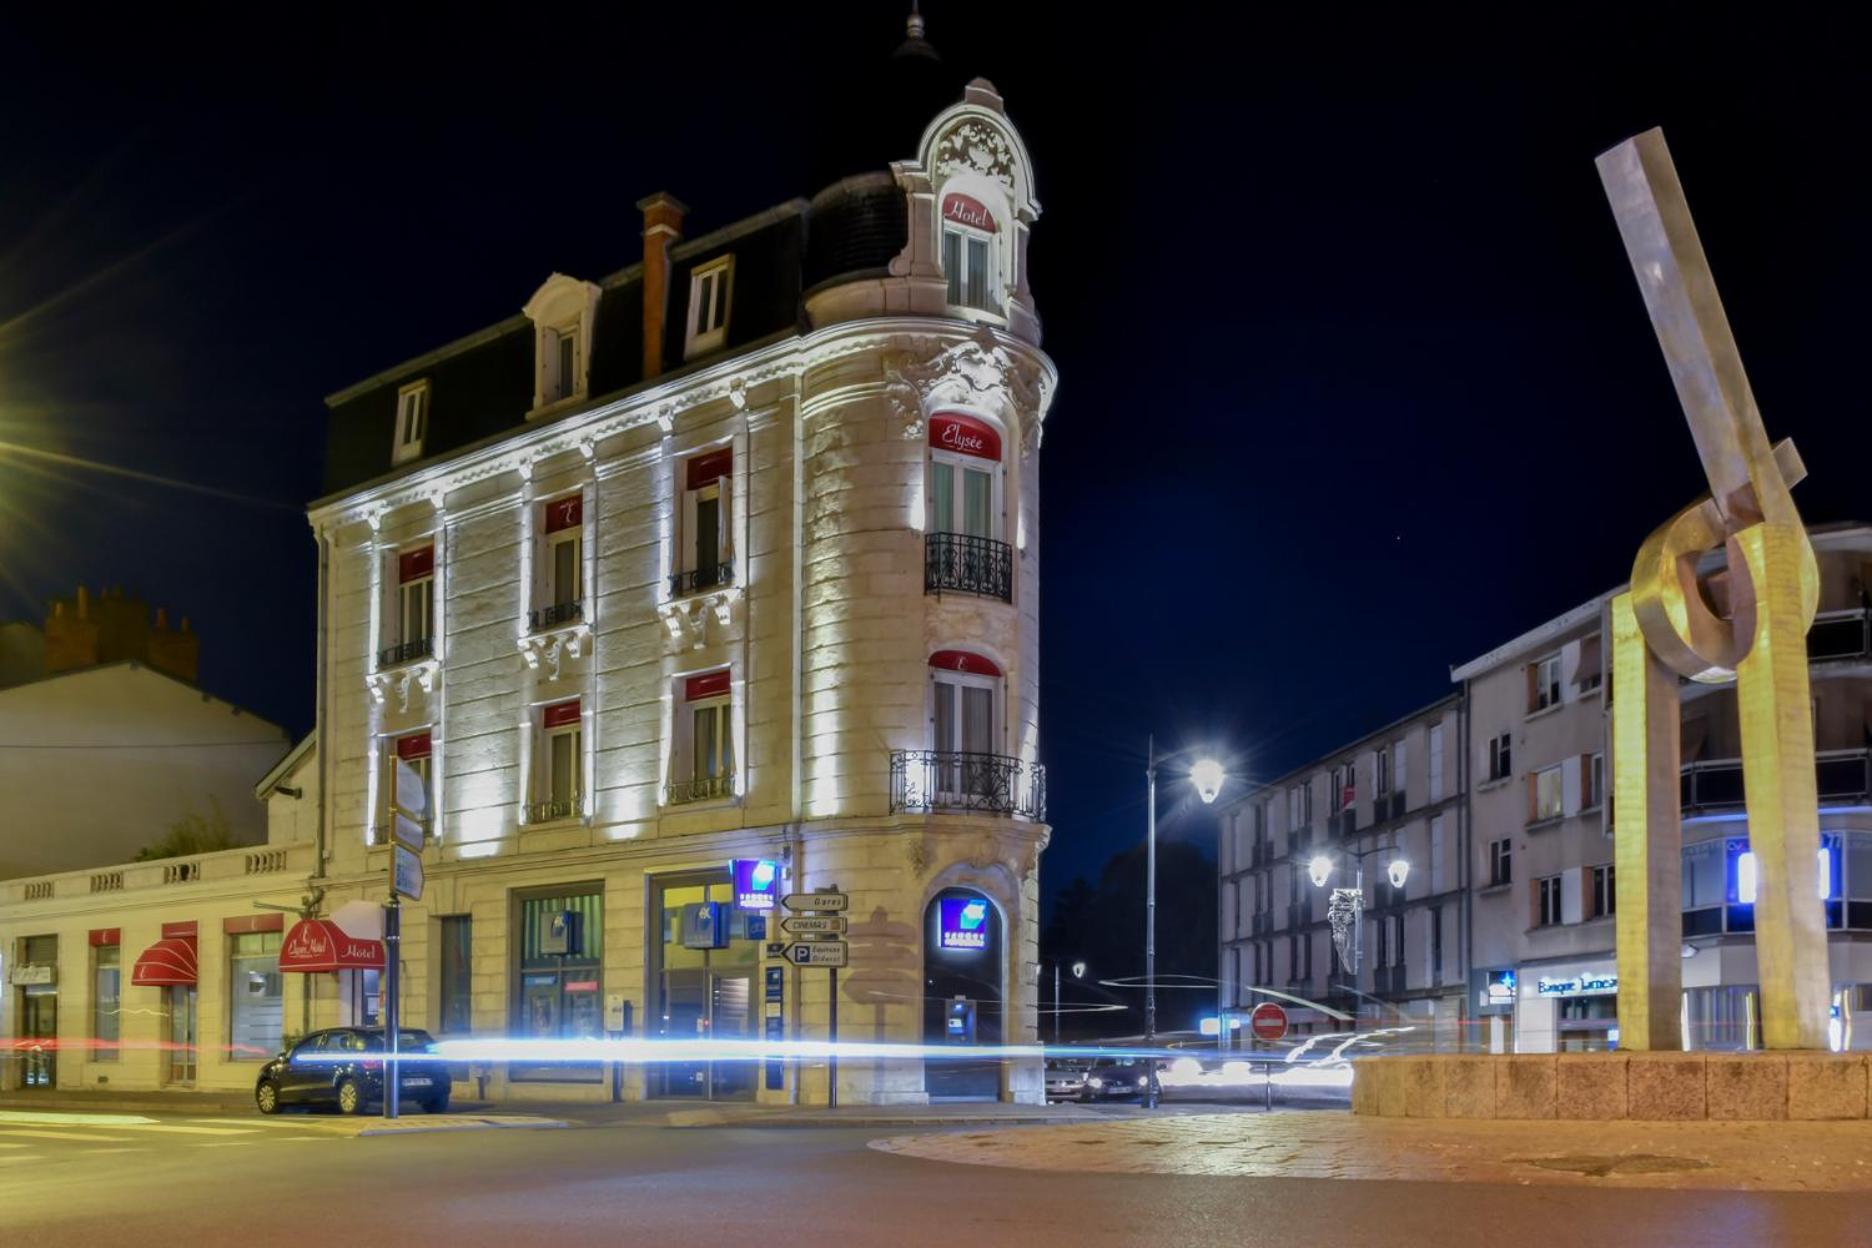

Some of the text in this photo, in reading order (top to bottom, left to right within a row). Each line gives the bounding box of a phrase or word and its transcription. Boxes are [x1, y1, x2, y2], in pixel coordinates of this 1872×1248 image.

[944, 200, 988, 227] Hotel
[942, 423, 984, 450] Elysée
[341, 943, 376, 959] Hotel
[1538, 981, 1576, 995] Banque
